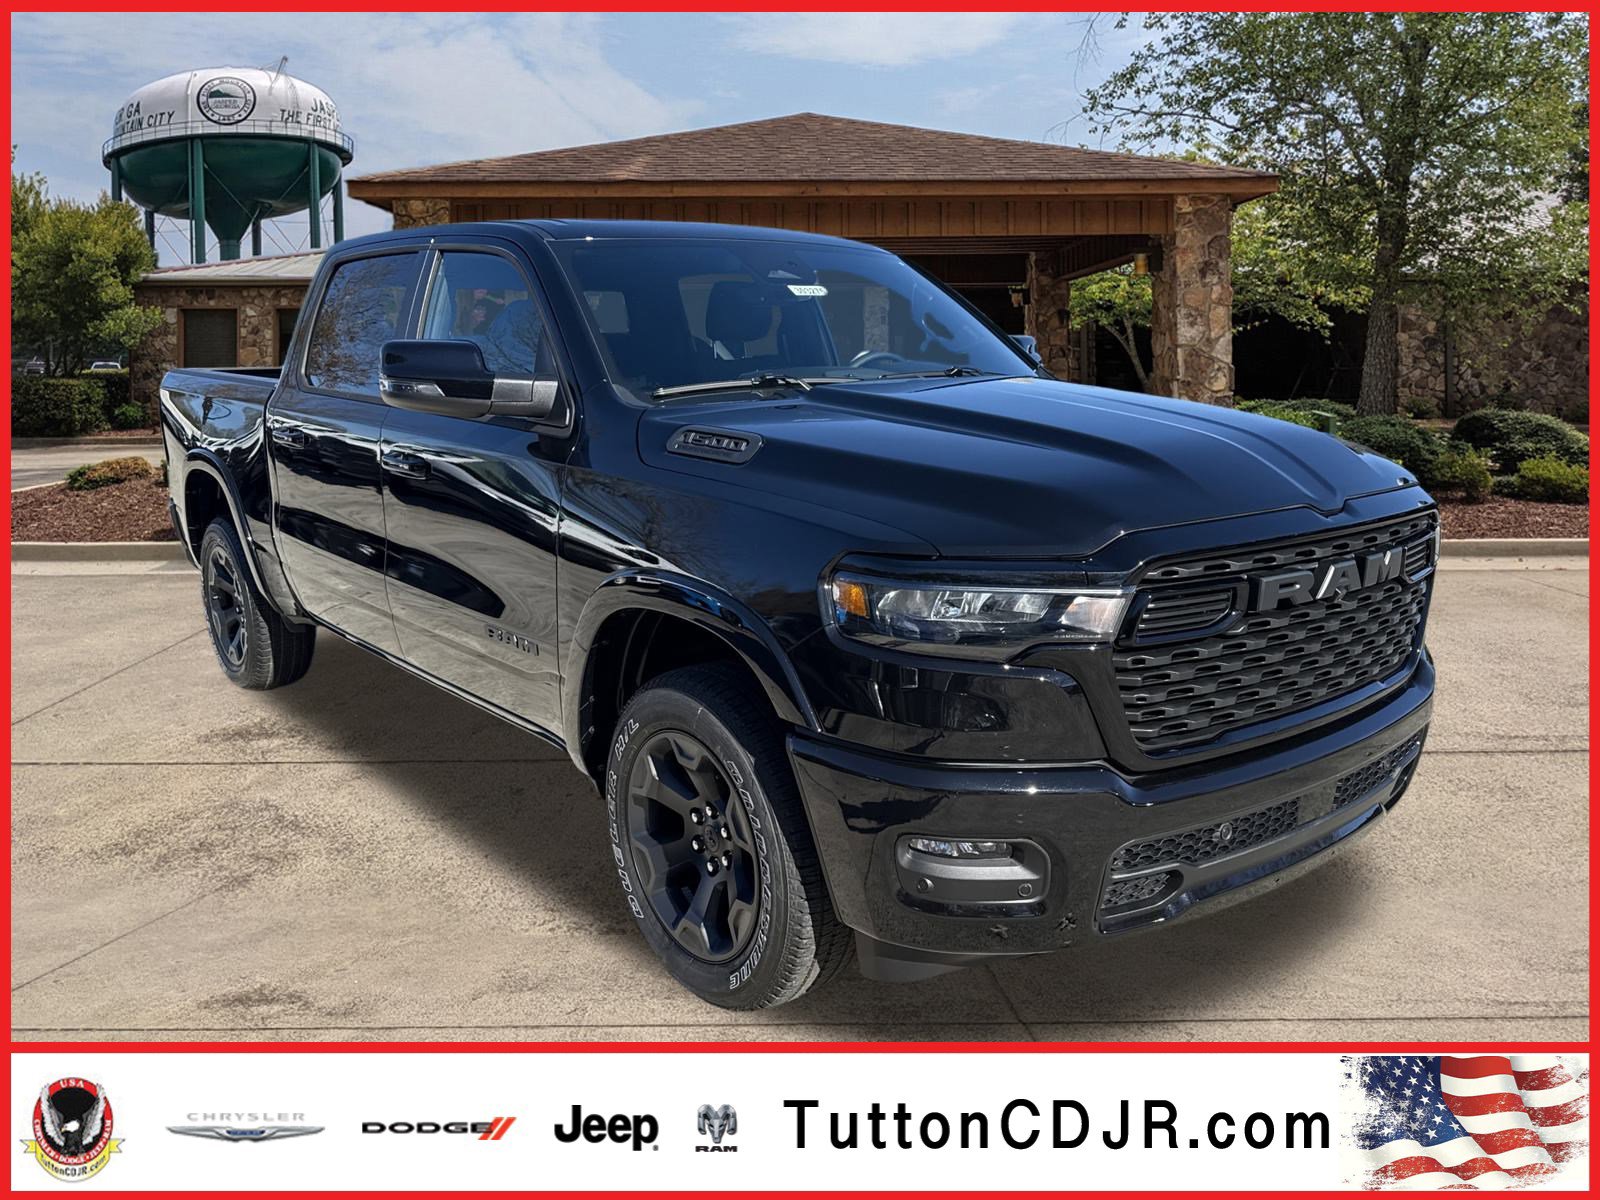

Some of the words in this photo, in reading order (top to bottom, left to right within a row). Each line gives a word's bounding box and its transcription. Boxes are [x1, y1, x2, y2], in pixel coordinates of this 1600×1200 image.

[126, 100, 141, 119] GA
[147, 110, 175, 128] CITY
[280, 108, 303, 124] THE
[306, 112, 332, 129] FIRST
[683, 431, 748, 452] 1500
[1249, 546, 1403, 612] RAM
[724, 760, 772, 989] BRIDGESTONE
